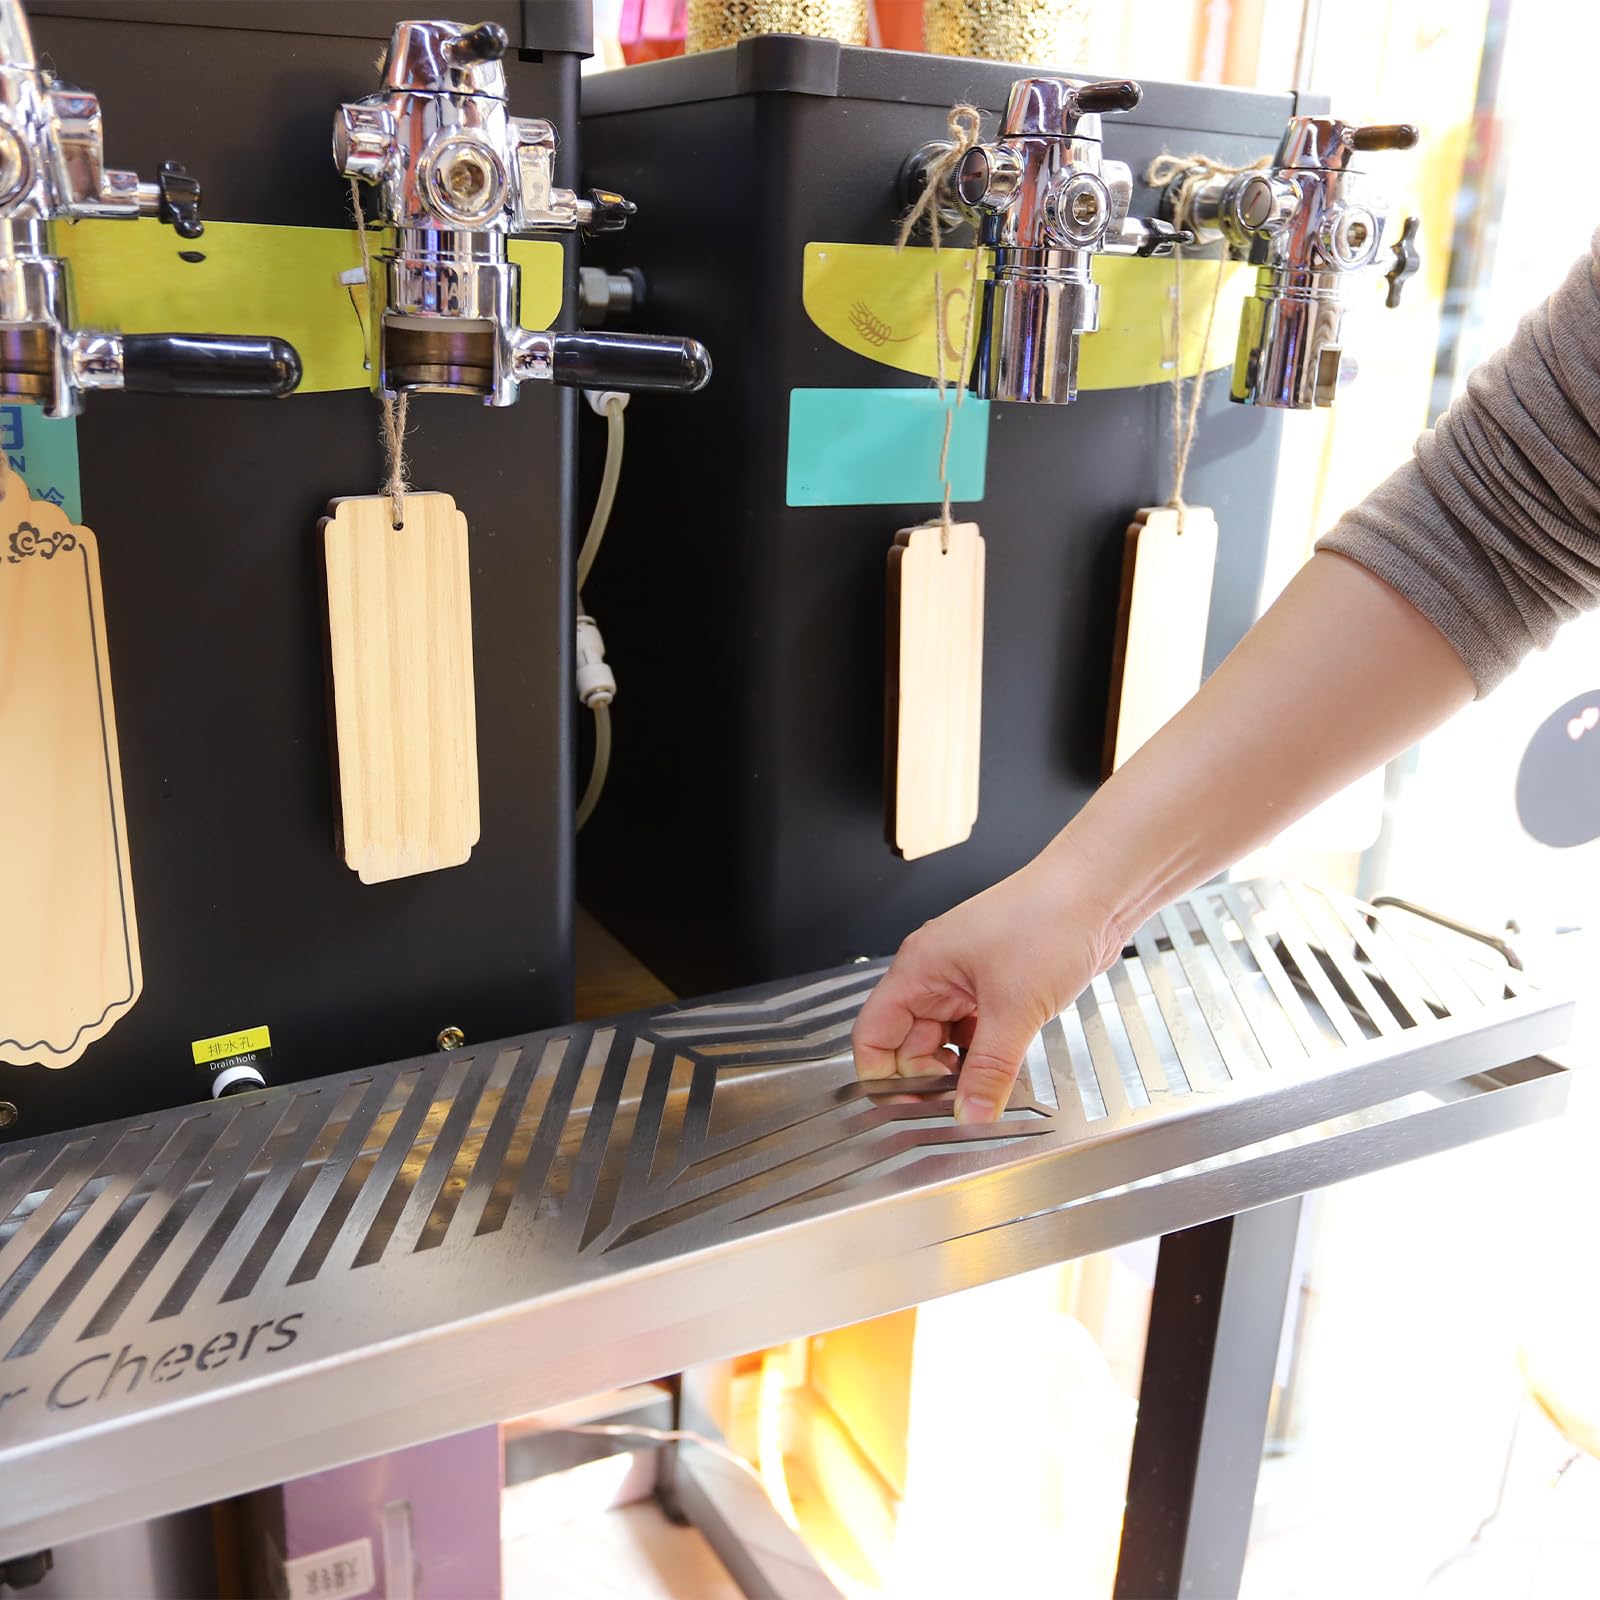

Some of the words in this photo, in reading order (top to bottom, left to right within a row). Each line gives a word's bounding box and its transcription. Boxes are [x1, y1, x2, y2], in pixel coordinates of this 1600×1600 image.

[208, 1036, 254, 1057] 排水孔
[209, 1059, 235, 1071] Drain
[235, 1053, 257, 1064] hole
[46, 1312, 304, 1412] Cheers
